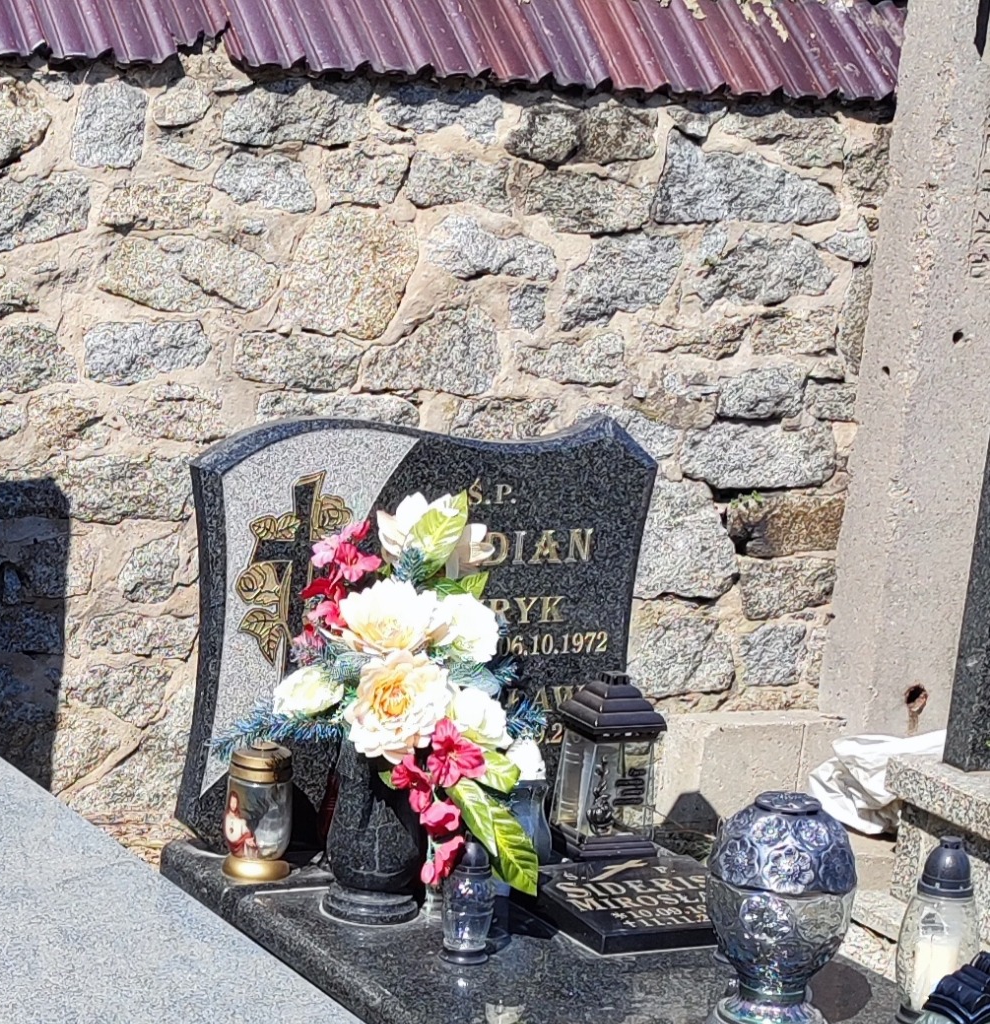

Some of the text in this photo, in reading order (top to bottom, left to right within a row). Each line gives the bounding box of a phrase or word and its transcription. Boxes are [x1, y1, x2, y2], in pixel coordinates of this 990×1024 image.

[483, 528, 594, 566] DIAN
[490, 596, 565, 624] RYK
[555, 875, 706, 898] SIDERIS
[637, 914, 711, 927] 11.11.2
